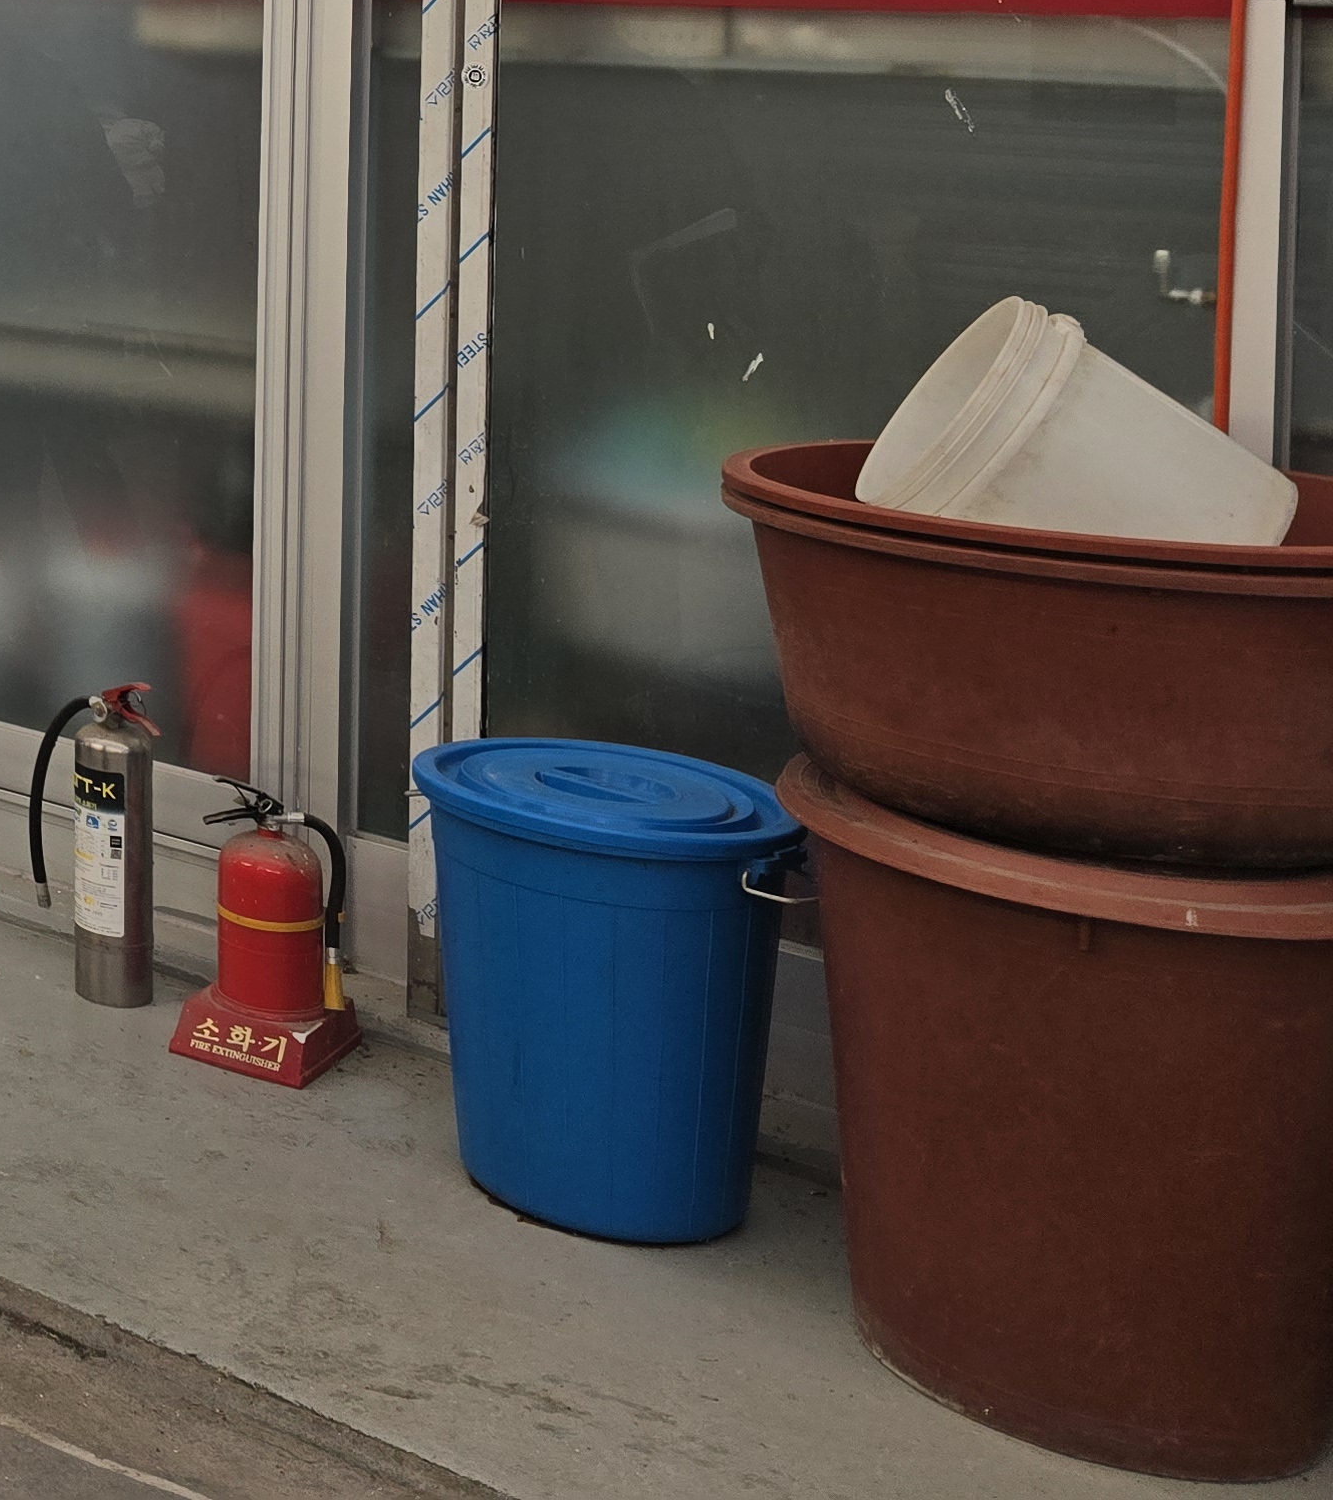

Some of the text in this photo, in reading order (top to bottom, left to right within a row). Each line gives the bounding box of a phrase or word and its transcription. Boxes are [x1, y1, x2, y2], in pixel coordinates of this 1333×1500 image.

[190, 1038, 282, 1073] FIRE EXTINGUISHER
[192, 1017, 288, 1064] 소화기
